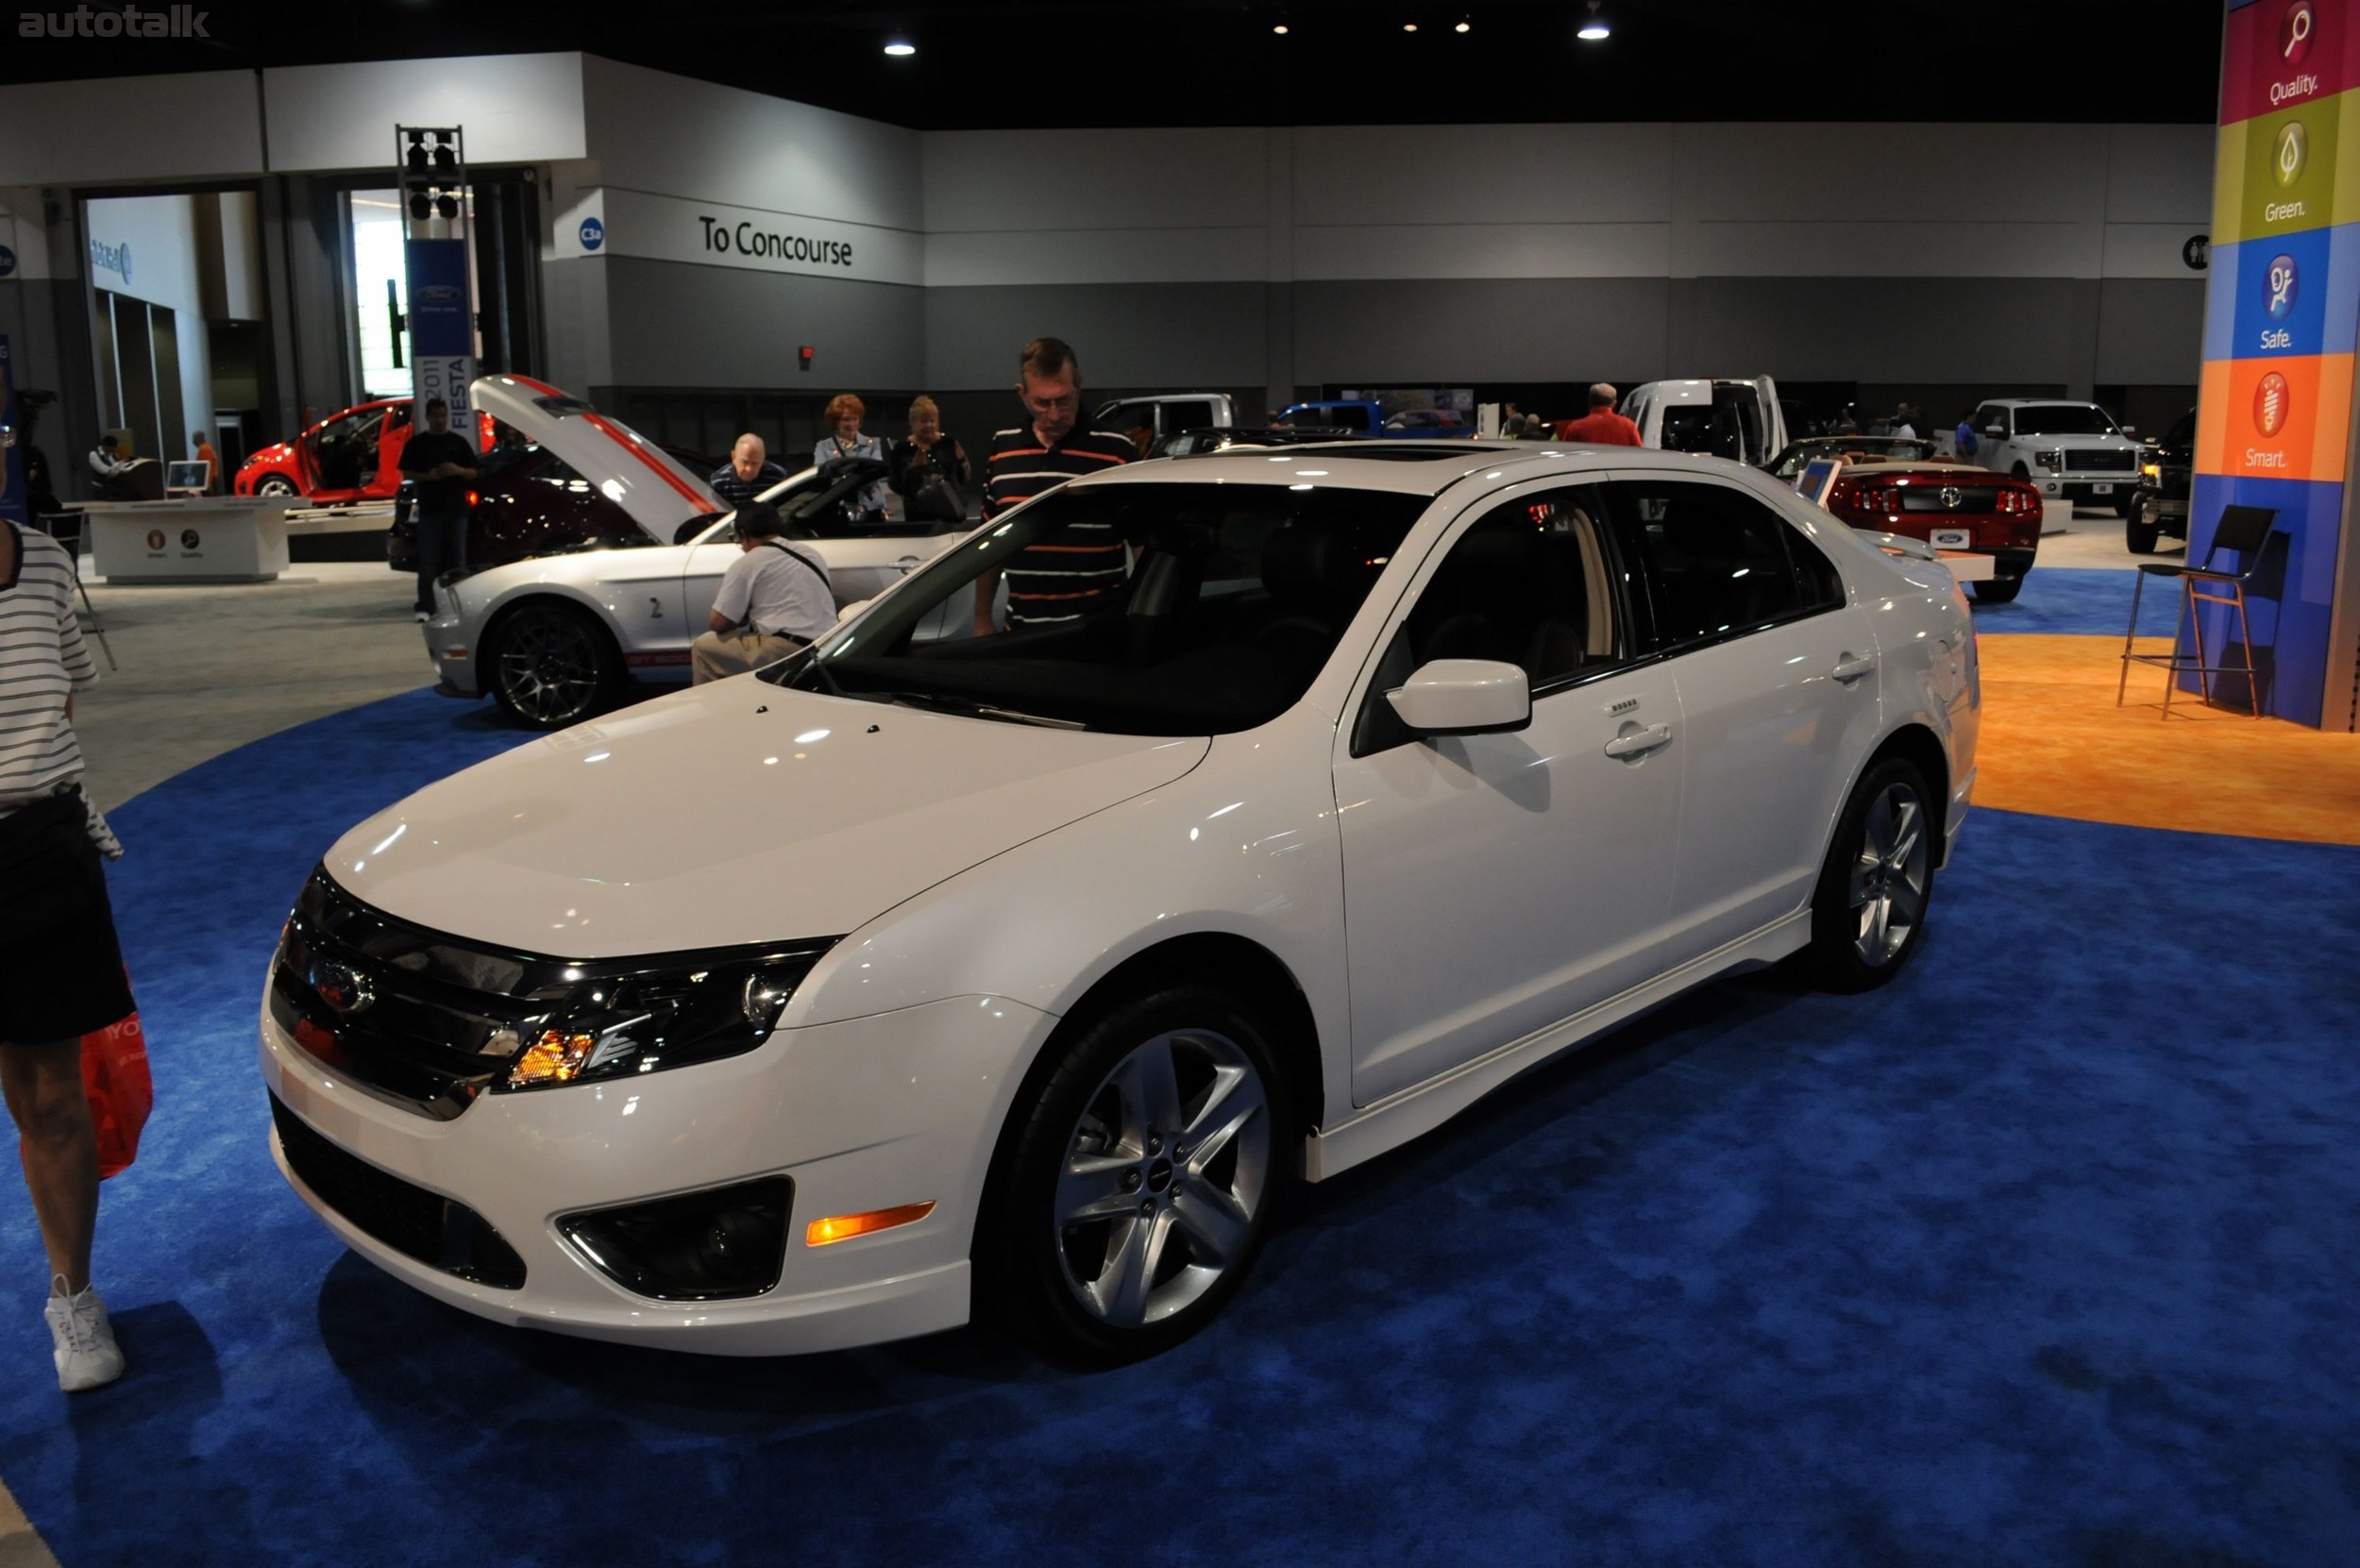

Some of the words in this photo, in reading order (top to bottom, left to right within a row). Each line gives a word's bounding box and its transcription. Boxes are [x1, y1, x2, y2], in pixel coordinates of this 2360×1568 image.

[2269, 75, 2318, 106] Quality.
[2266, 201, 2305, 222] Green.
[699, 215, 730, 253] To
[735, 221, 852, 266] Concourse
[2260, 328, 2291, 349] Safe.
[448, 359, 468, 430] FIESTA
[2245, 448, 2286, 468] Smart.
